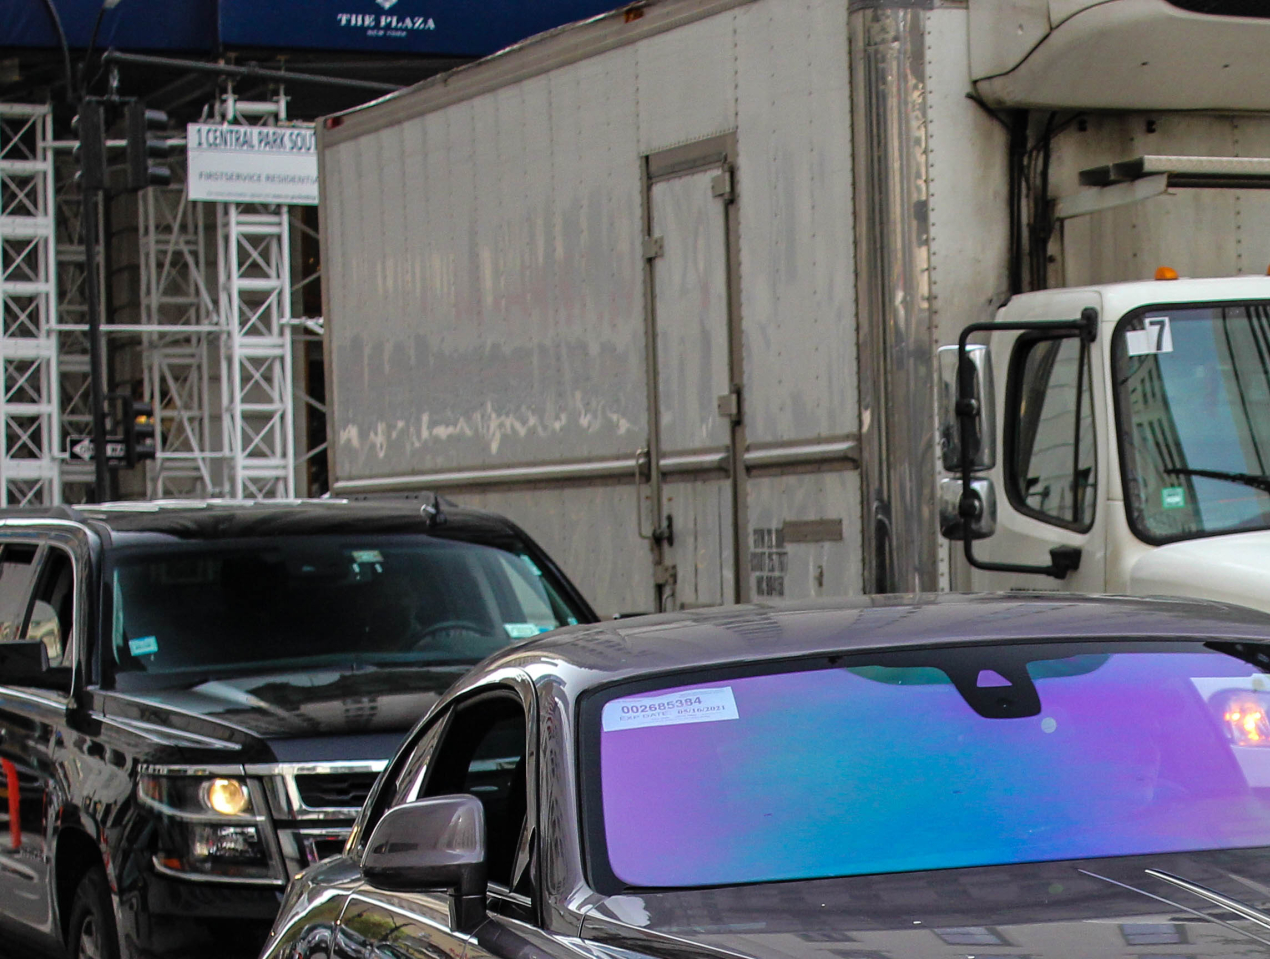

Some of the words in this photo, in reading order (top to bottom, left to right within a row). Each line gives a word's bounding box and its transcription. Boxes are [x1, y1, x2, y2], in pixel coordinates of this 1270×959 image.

[337, 13, 375, 27] THE
[380, 15, 435, 30] PLAZA
[196, 126, 203, 147] 1
[205, 127, 255, 149] CENTRAL
[258, 130, 286, 151] PARK
[199, 171, 261, 183] FIRSTSERVICE
[1149, 319, 1167, 351] 7
[621, 697, 702, 715] 002685384
